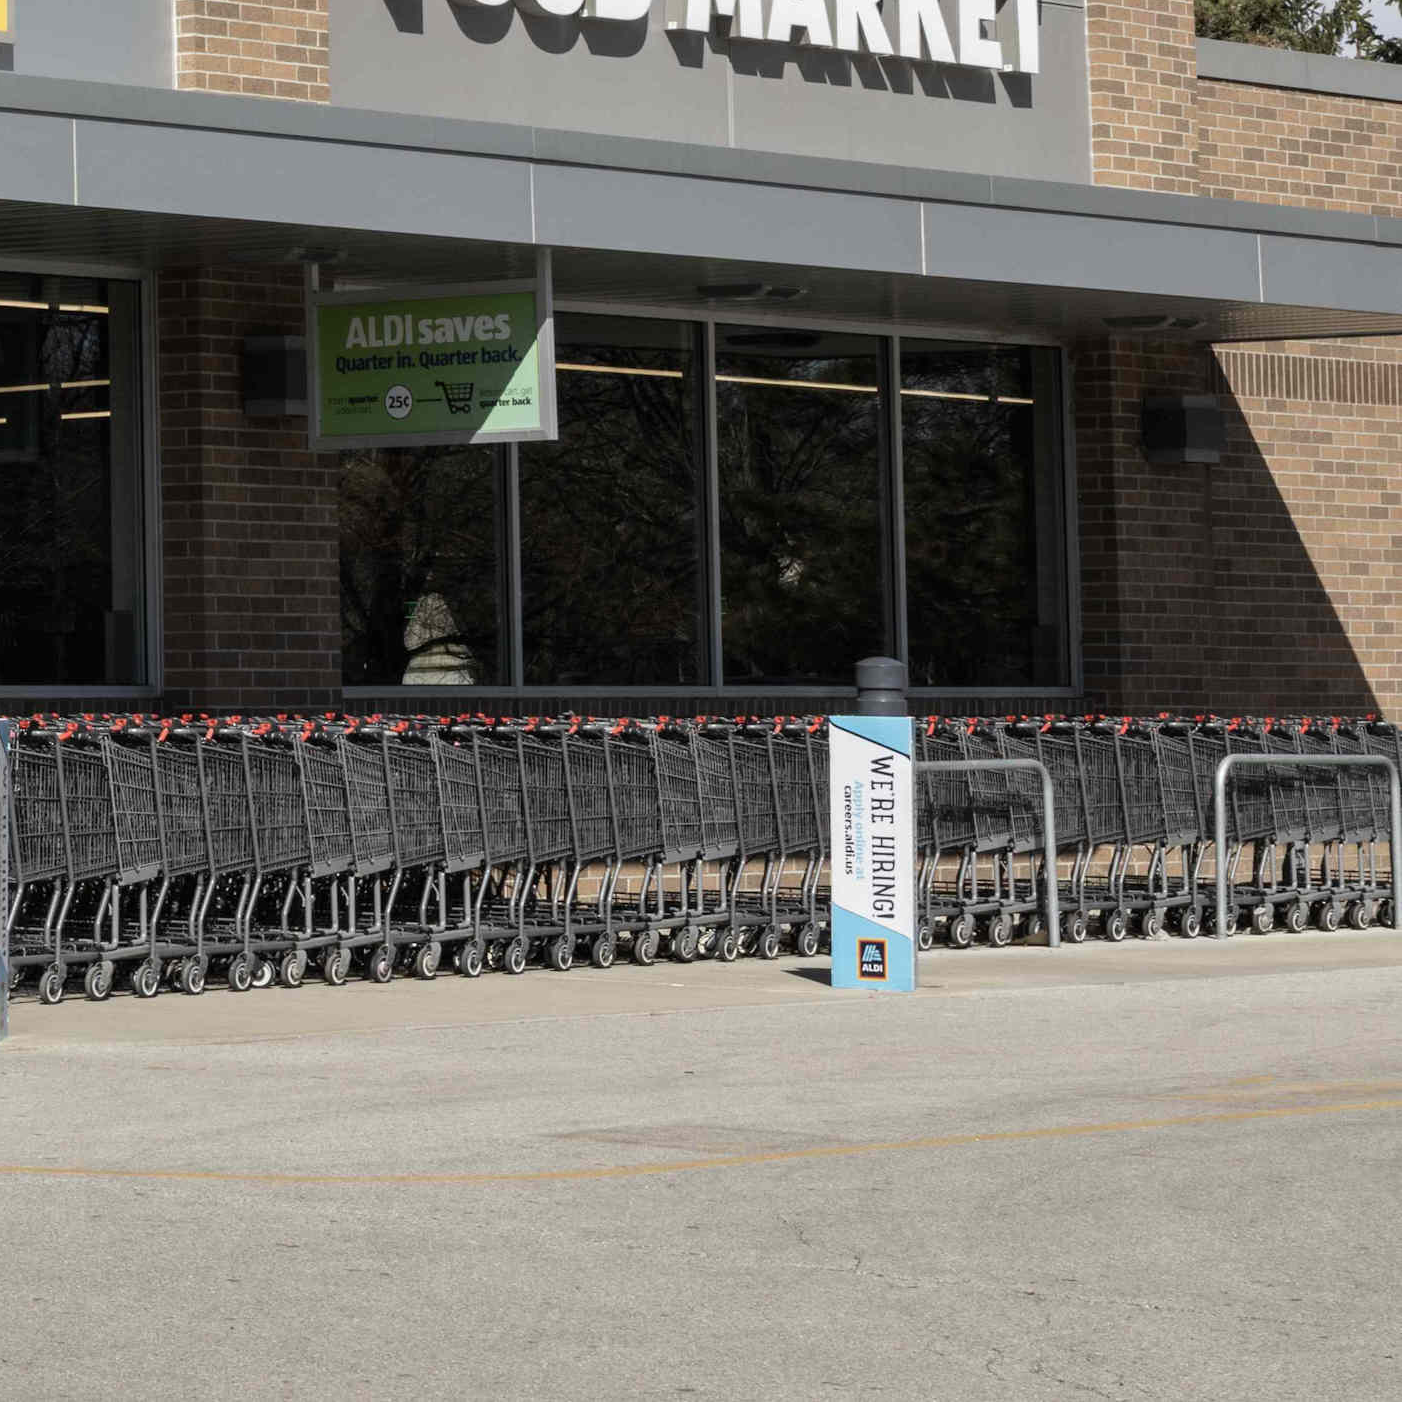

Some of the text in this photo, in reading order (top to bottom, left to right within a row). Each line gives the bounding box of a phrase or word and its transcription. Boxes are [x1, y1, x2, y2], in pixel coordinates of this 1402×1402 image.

[346, 314, 511, 348] ALDI saves
[336, 345, 523, 374] Quarter in. Quarter back.
[388, 394, 410, 409] 25¢
[844, 785, 855, 875] careers.aldi.us
[870, 755, 896, 919] WE'RE HIRING!
[862, 964, 884, 973] ALDI
